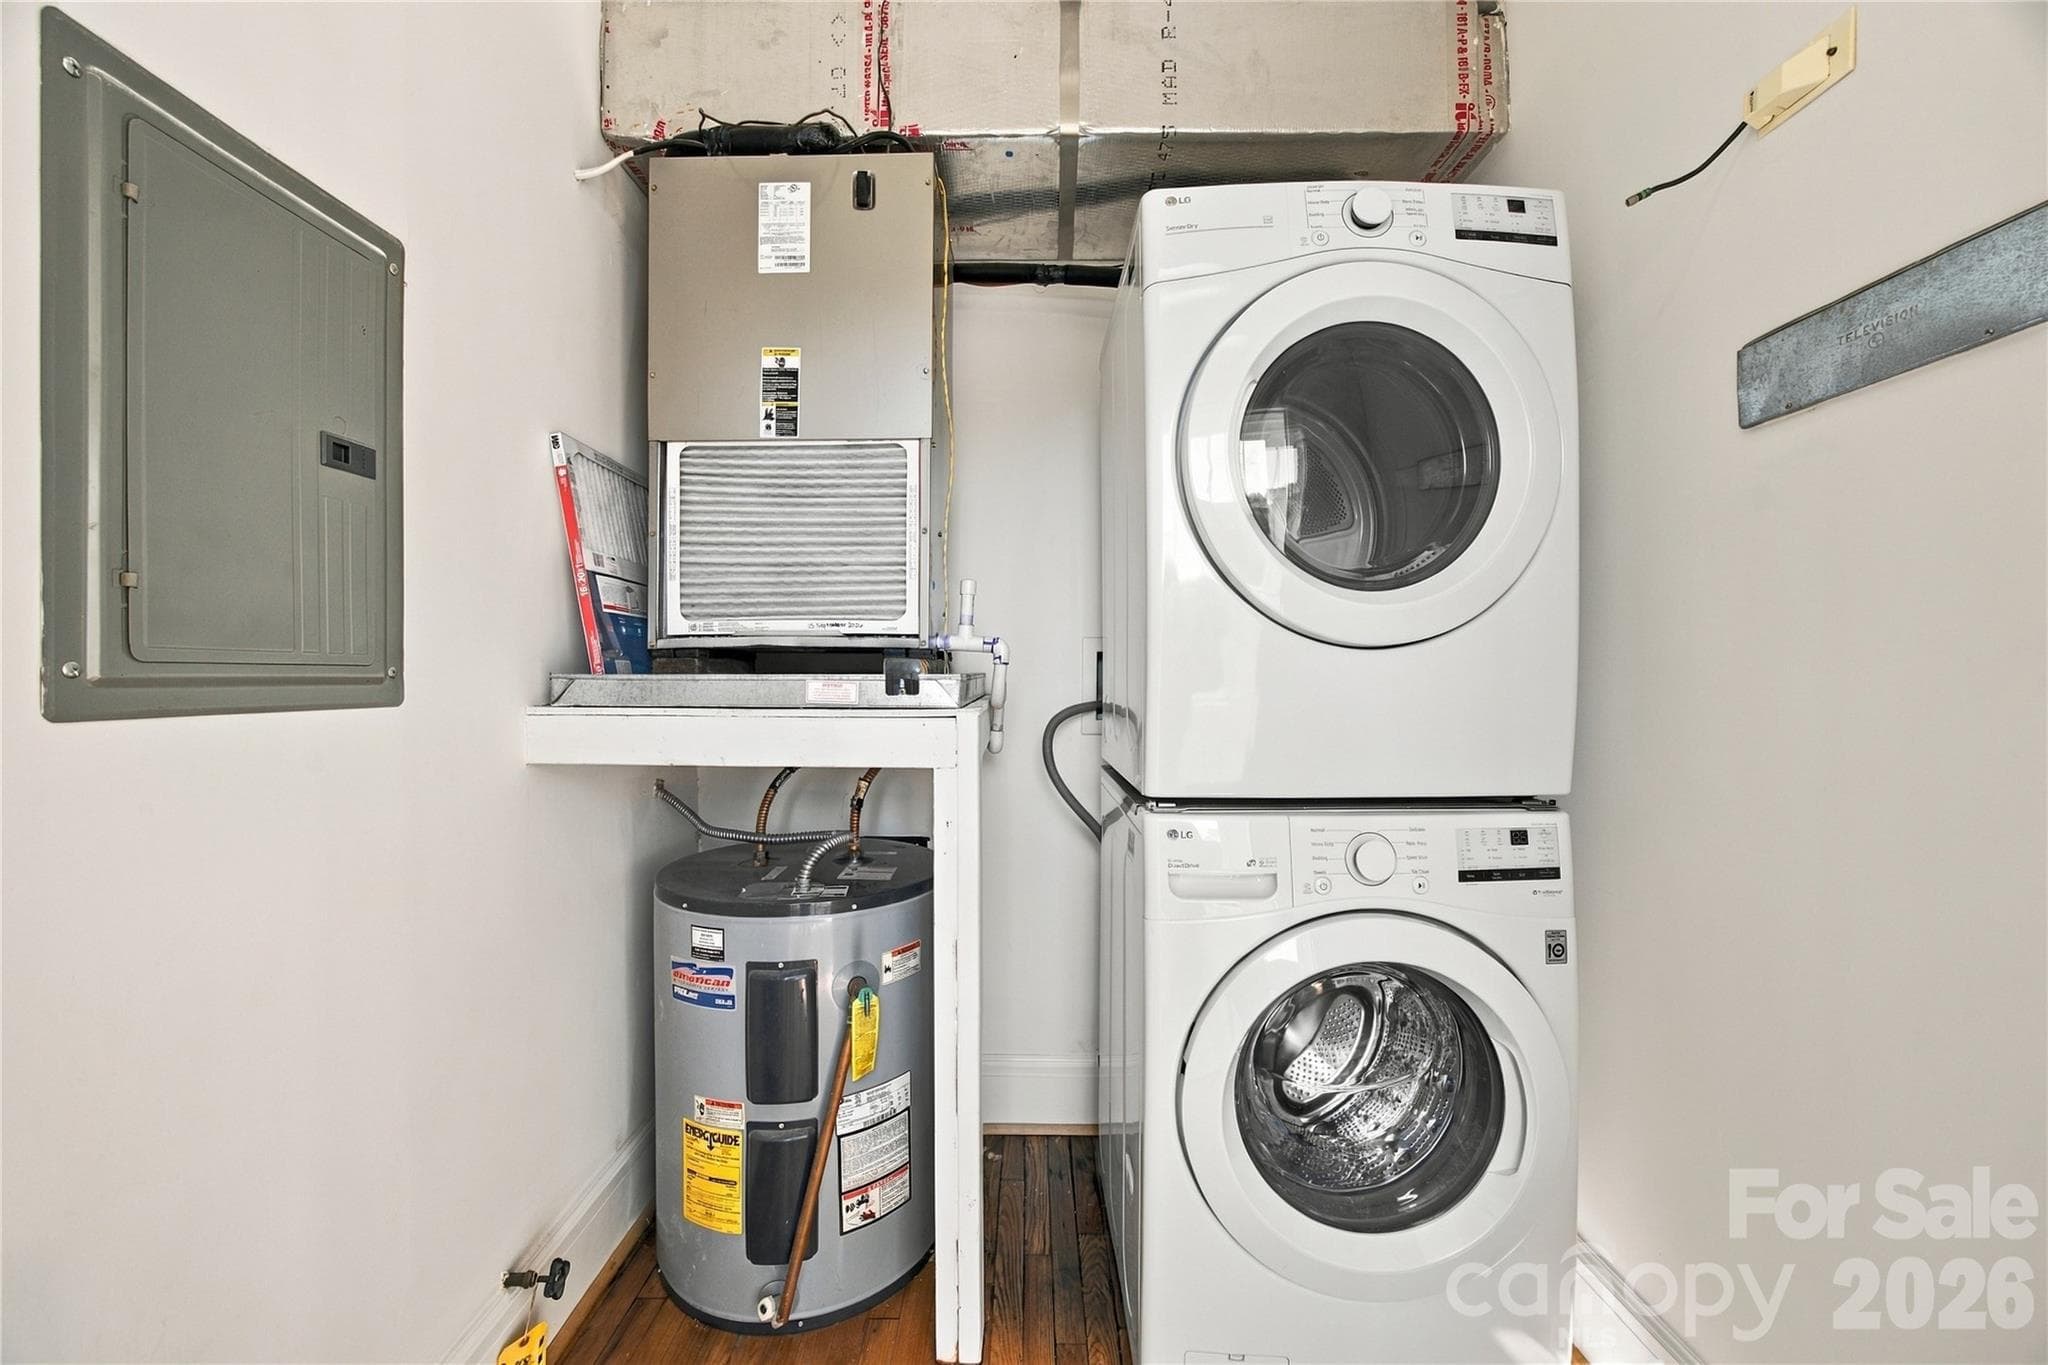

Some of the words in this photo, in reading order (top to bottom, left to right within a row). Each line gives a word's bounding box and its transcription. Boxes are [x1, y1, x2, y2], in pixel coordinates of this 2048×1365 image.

[1178, 196, 1192, 205] LG
[1836, 303, 1921, 346] TELEVISION
[1180, 831, 1193, 839] LG
